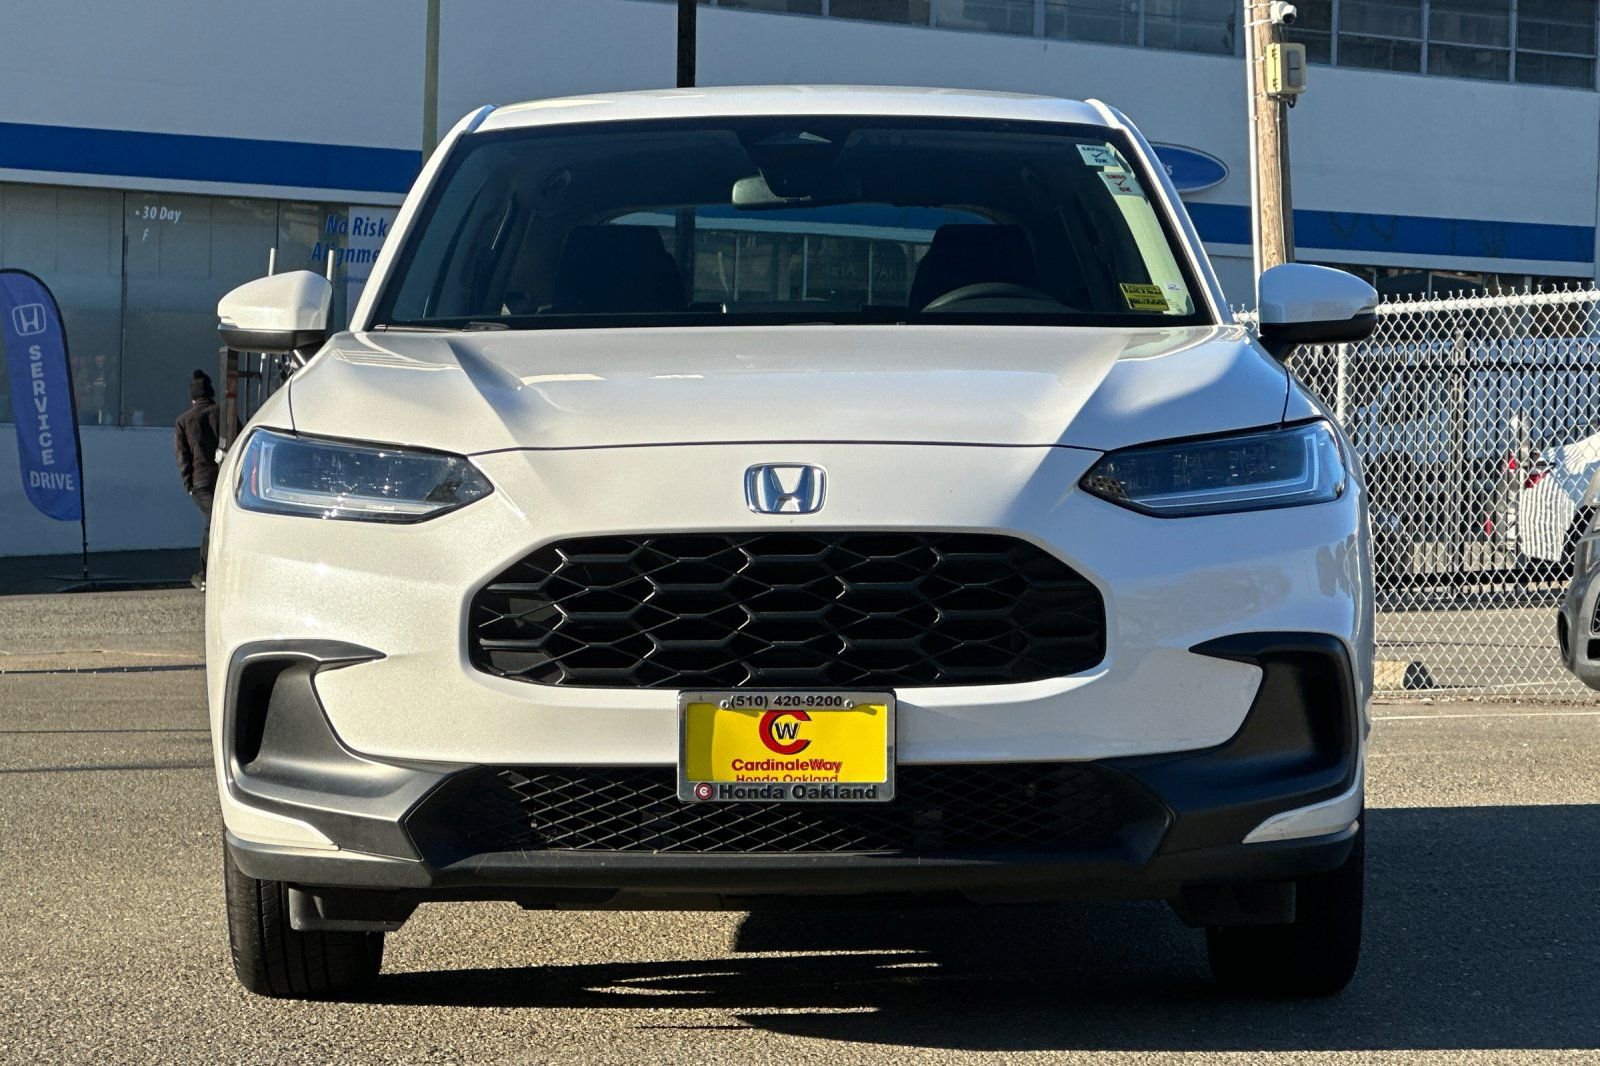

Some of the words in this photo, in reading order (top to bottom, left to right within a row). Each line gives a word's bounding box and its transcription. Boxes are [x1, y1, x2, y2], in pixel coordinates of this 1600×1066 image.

[142, 206, 158, 220] 30
[159, 206, 182, 224] Day
[324, 214, 349, 236] No
[352, 217, 389, 238] Risk
[311, 241, 381, 267] Algnme
[28, 344, 55, 466] SERVICE
[29, 470, 75, 491] DRIVE
[730, 695, 769, 709] (510)
[773, 695, 843, 707] 420-9200
[731, 759, 843, 773] CardinaleWay
[718, 784, 784, 799] Honda
[791, 784, 877, 799] Oakland
